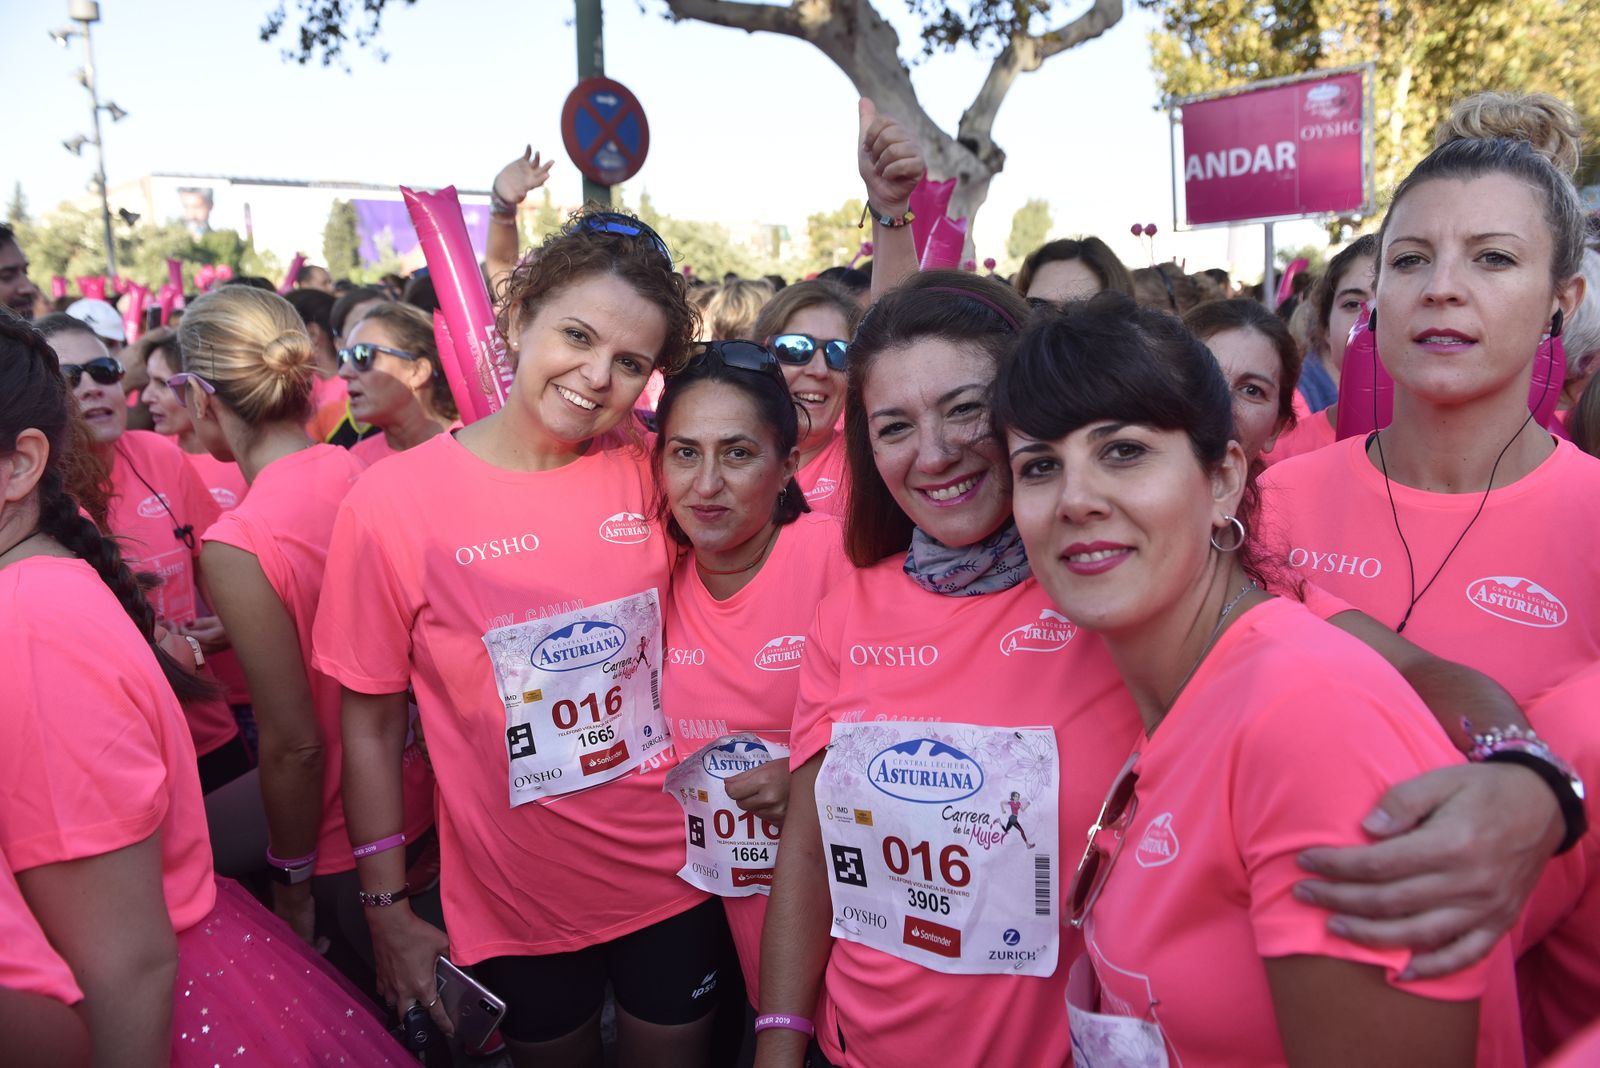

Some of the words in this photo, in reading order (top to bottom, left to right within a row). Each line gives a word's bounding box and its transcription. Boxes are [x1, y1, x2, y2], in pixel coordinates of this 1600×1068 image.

[1300, 119, 1362, 141] OYSHO
[1185, 141, 1297, 183] ANDAR
[455, 533, 540, 566] OYSHO
[1288, 547, 1382, 579] OYSHO
[1472, 584, 1559, 624] ASTURIANA
[539, 634, 621, 667] ASTURIANA
[850, 644, 939, 667] OYSHO
[602, 656, 633, 674] Carrera
[552, 685, 623, 730] 016
[577, 724, 616, 747] 1665
[641, 734, 664, 752] ZURICH
[875, 759, 974, 790] ASTURIANA
[892, 759, 927, 768] CENTRAL
[931, 761, 970, 770] LECHERA
[513, 767, 562, 789] OYSHO
[941, 805, 991, 825] Carrera
[952, 823, 962, 834] de
[963, 823, 970, 835] la
[969, 823, 1008, 851] Mujer
[731, 846, 769, 862] 1664
[881, 835, 971, 888] 016
[692, 862, 719, 880] OYSHO
[907, 887, 951, 916] 3905
[842, 904, 888, 931] OYSHO
[920, 929, 952, 947] Santander
[988, 950, 1037, 961] ZURICH
